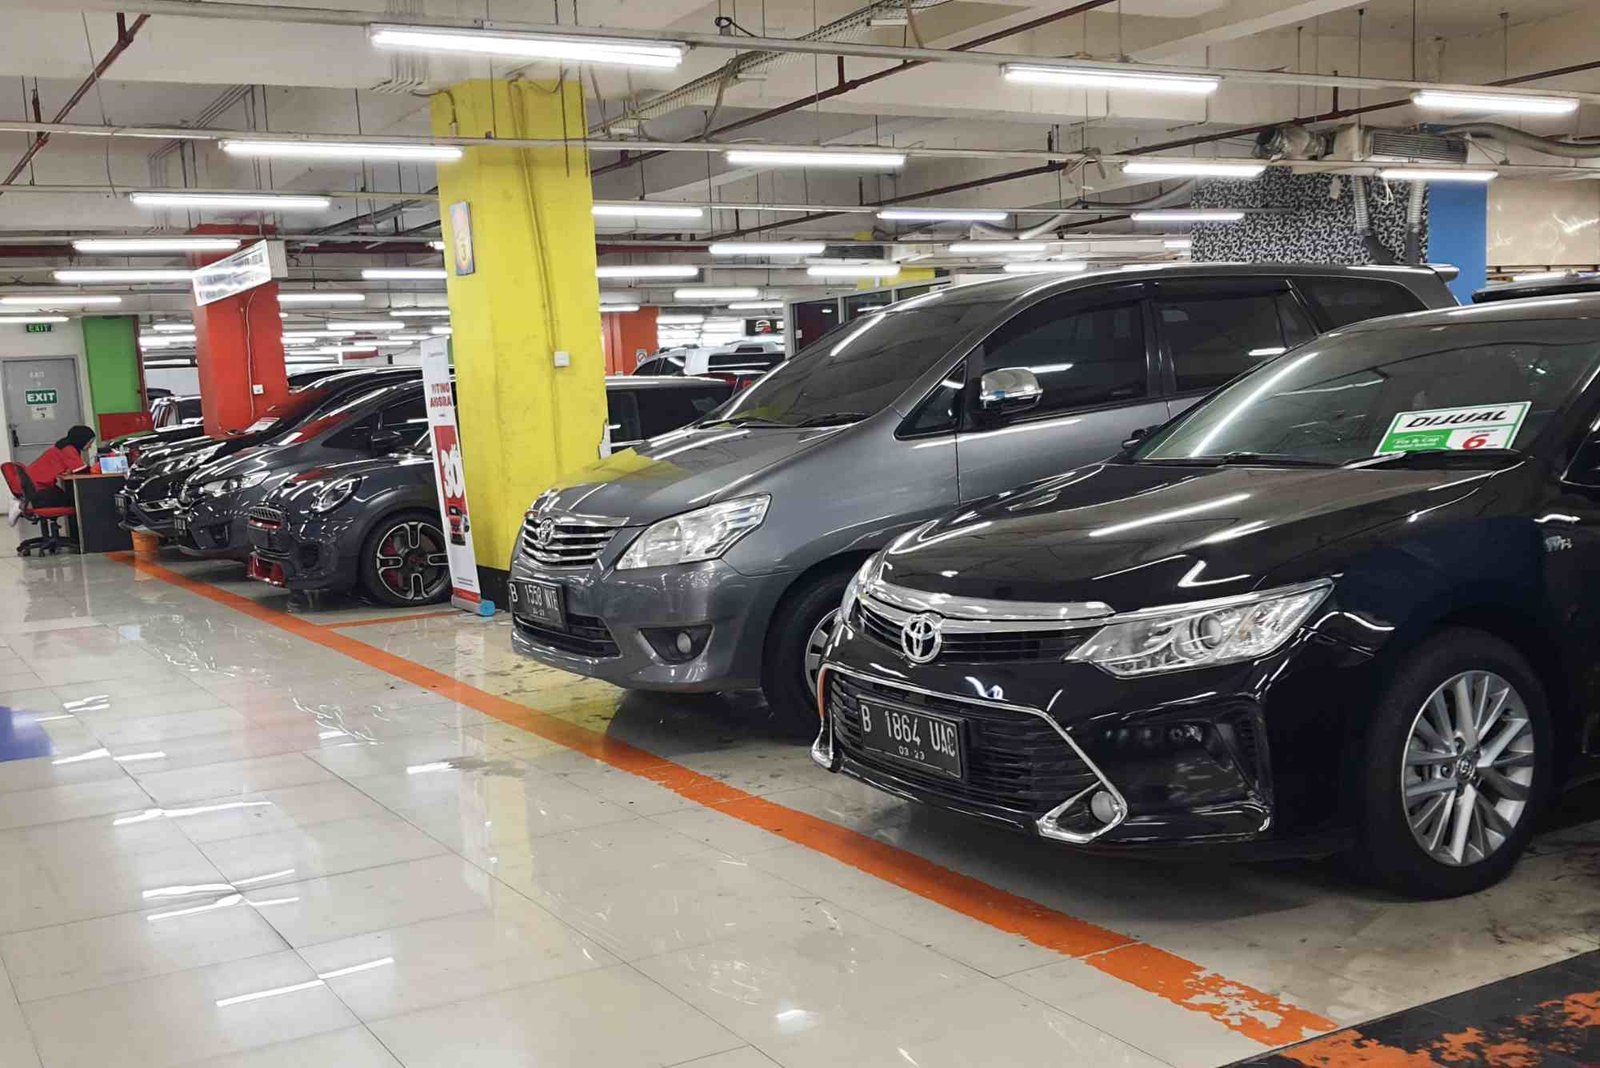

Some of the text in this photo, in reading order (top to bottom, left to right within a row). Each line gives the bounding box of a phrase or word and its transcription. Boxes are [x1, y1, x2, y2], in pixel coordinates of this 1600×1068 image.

[27, 392, 55, 402] EXIT
[1406, 410, 1507, 428] DIJUAL
[1462, 434, 1490, 450] 6
[510, 583, 518, 602] B
[861, 704, 955, 757] B 1864 UAC
